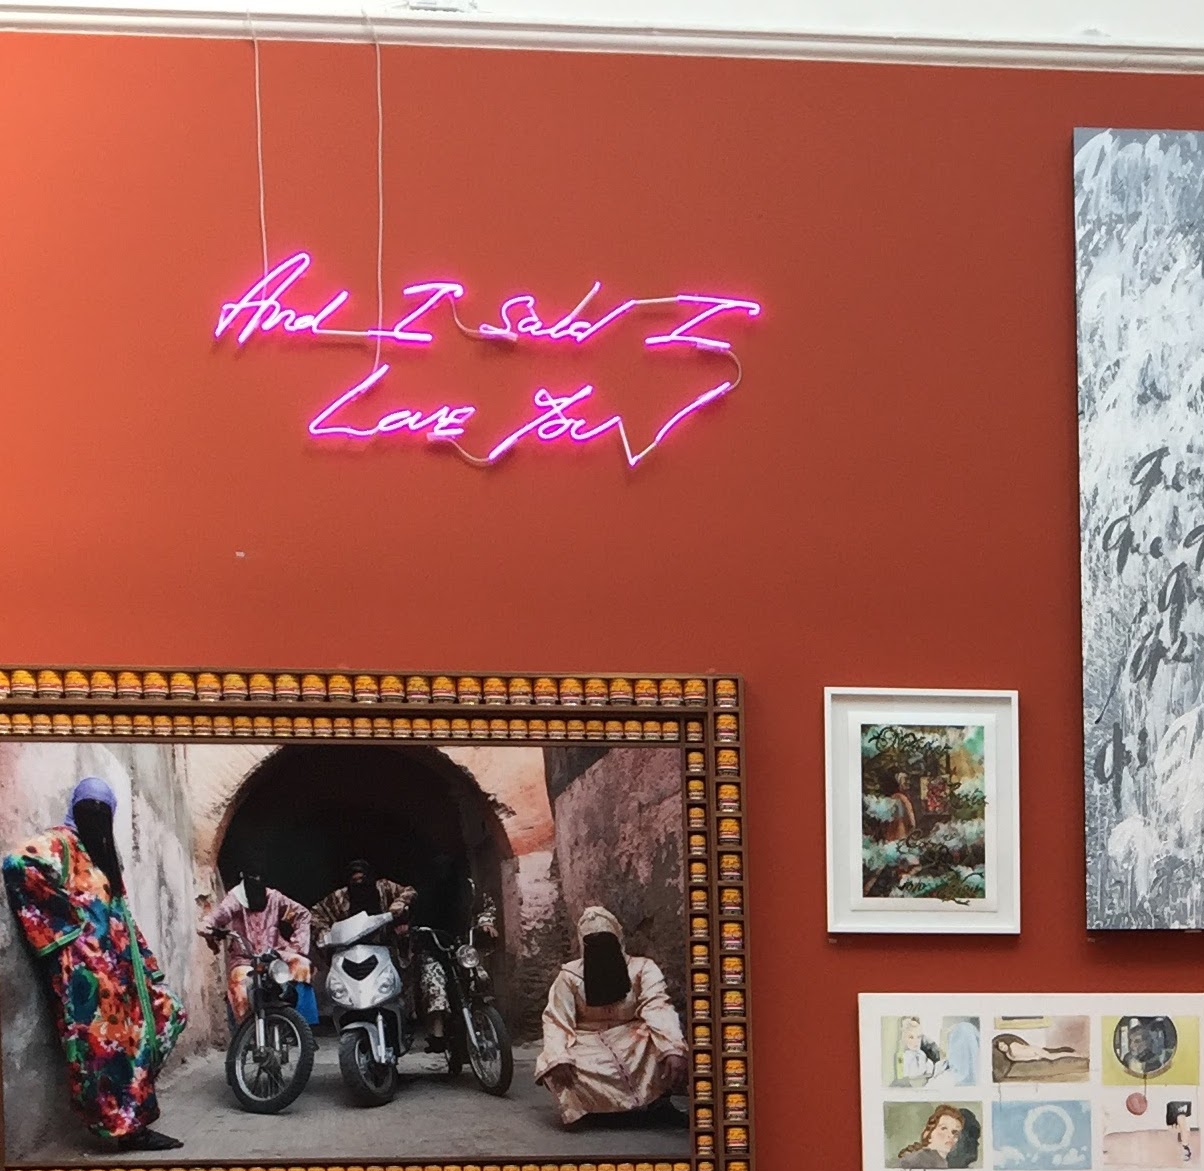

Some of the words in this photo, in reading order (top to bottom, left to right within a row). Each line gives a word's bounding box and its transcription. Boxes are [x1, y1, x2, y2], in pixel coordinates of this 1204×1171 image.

[214, 251, 349, 344] And
[384, 281, 464, 342] I
[644, 294, 761, 350] I
[308, 363, 476, 442] Love
[488, 384, 624, 460] You
